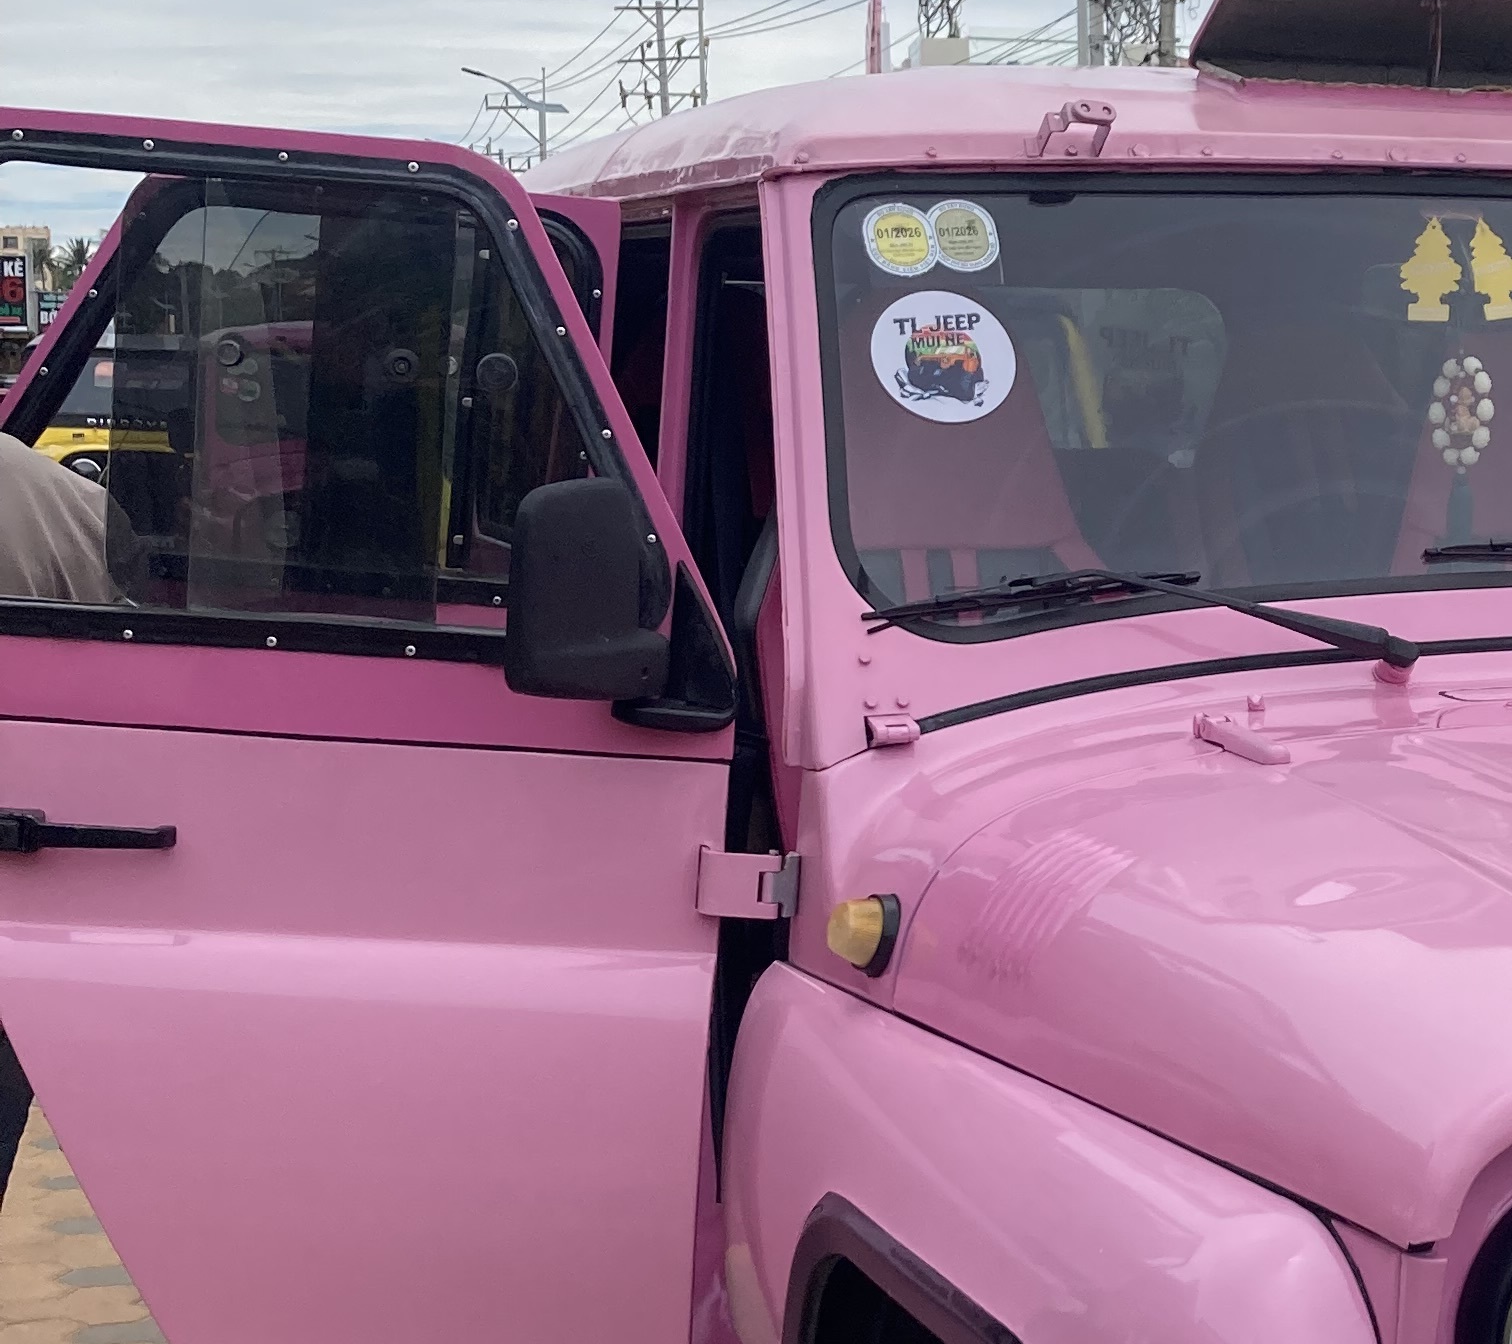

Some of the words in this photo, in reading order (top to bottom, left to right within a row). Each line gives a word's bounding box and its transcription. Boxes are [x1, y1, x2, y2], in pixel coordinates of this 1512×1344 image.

[876, 226, 922, 239] 01/2026
[938, 225, 979, 238] 01/2026
[929, 312, 981, 333] JEEP
